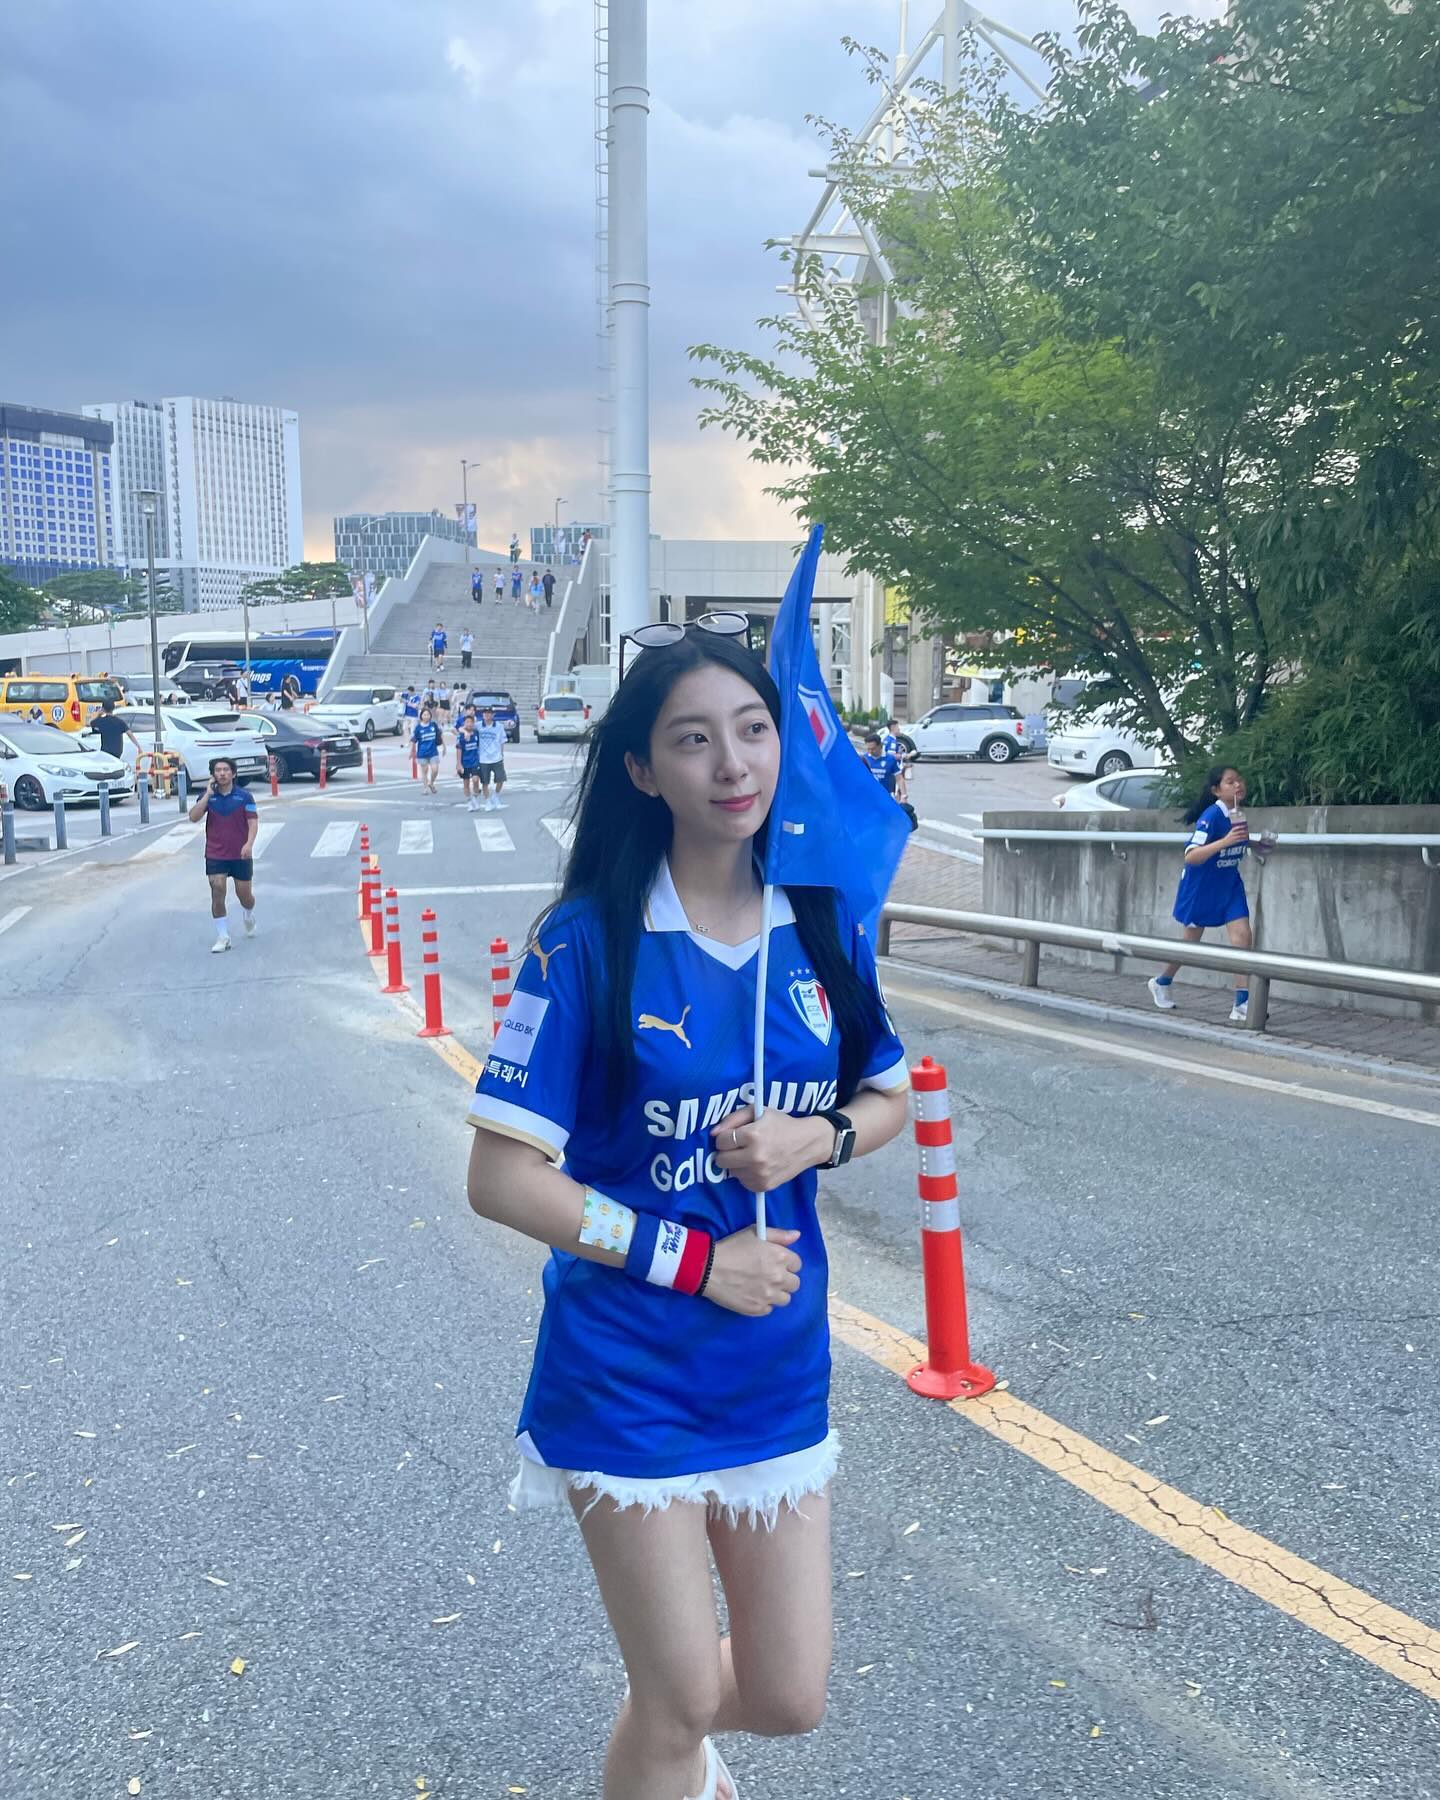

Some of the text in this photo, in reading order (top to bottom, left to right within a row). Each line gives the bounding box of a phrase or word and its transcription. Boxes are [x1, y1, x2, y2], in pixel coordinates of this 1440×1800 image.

[248, 669, 272, 684] ings
[504, 1019, 536, 1036] QLED 8K
[650, 1147, 728, 1193] Gala
